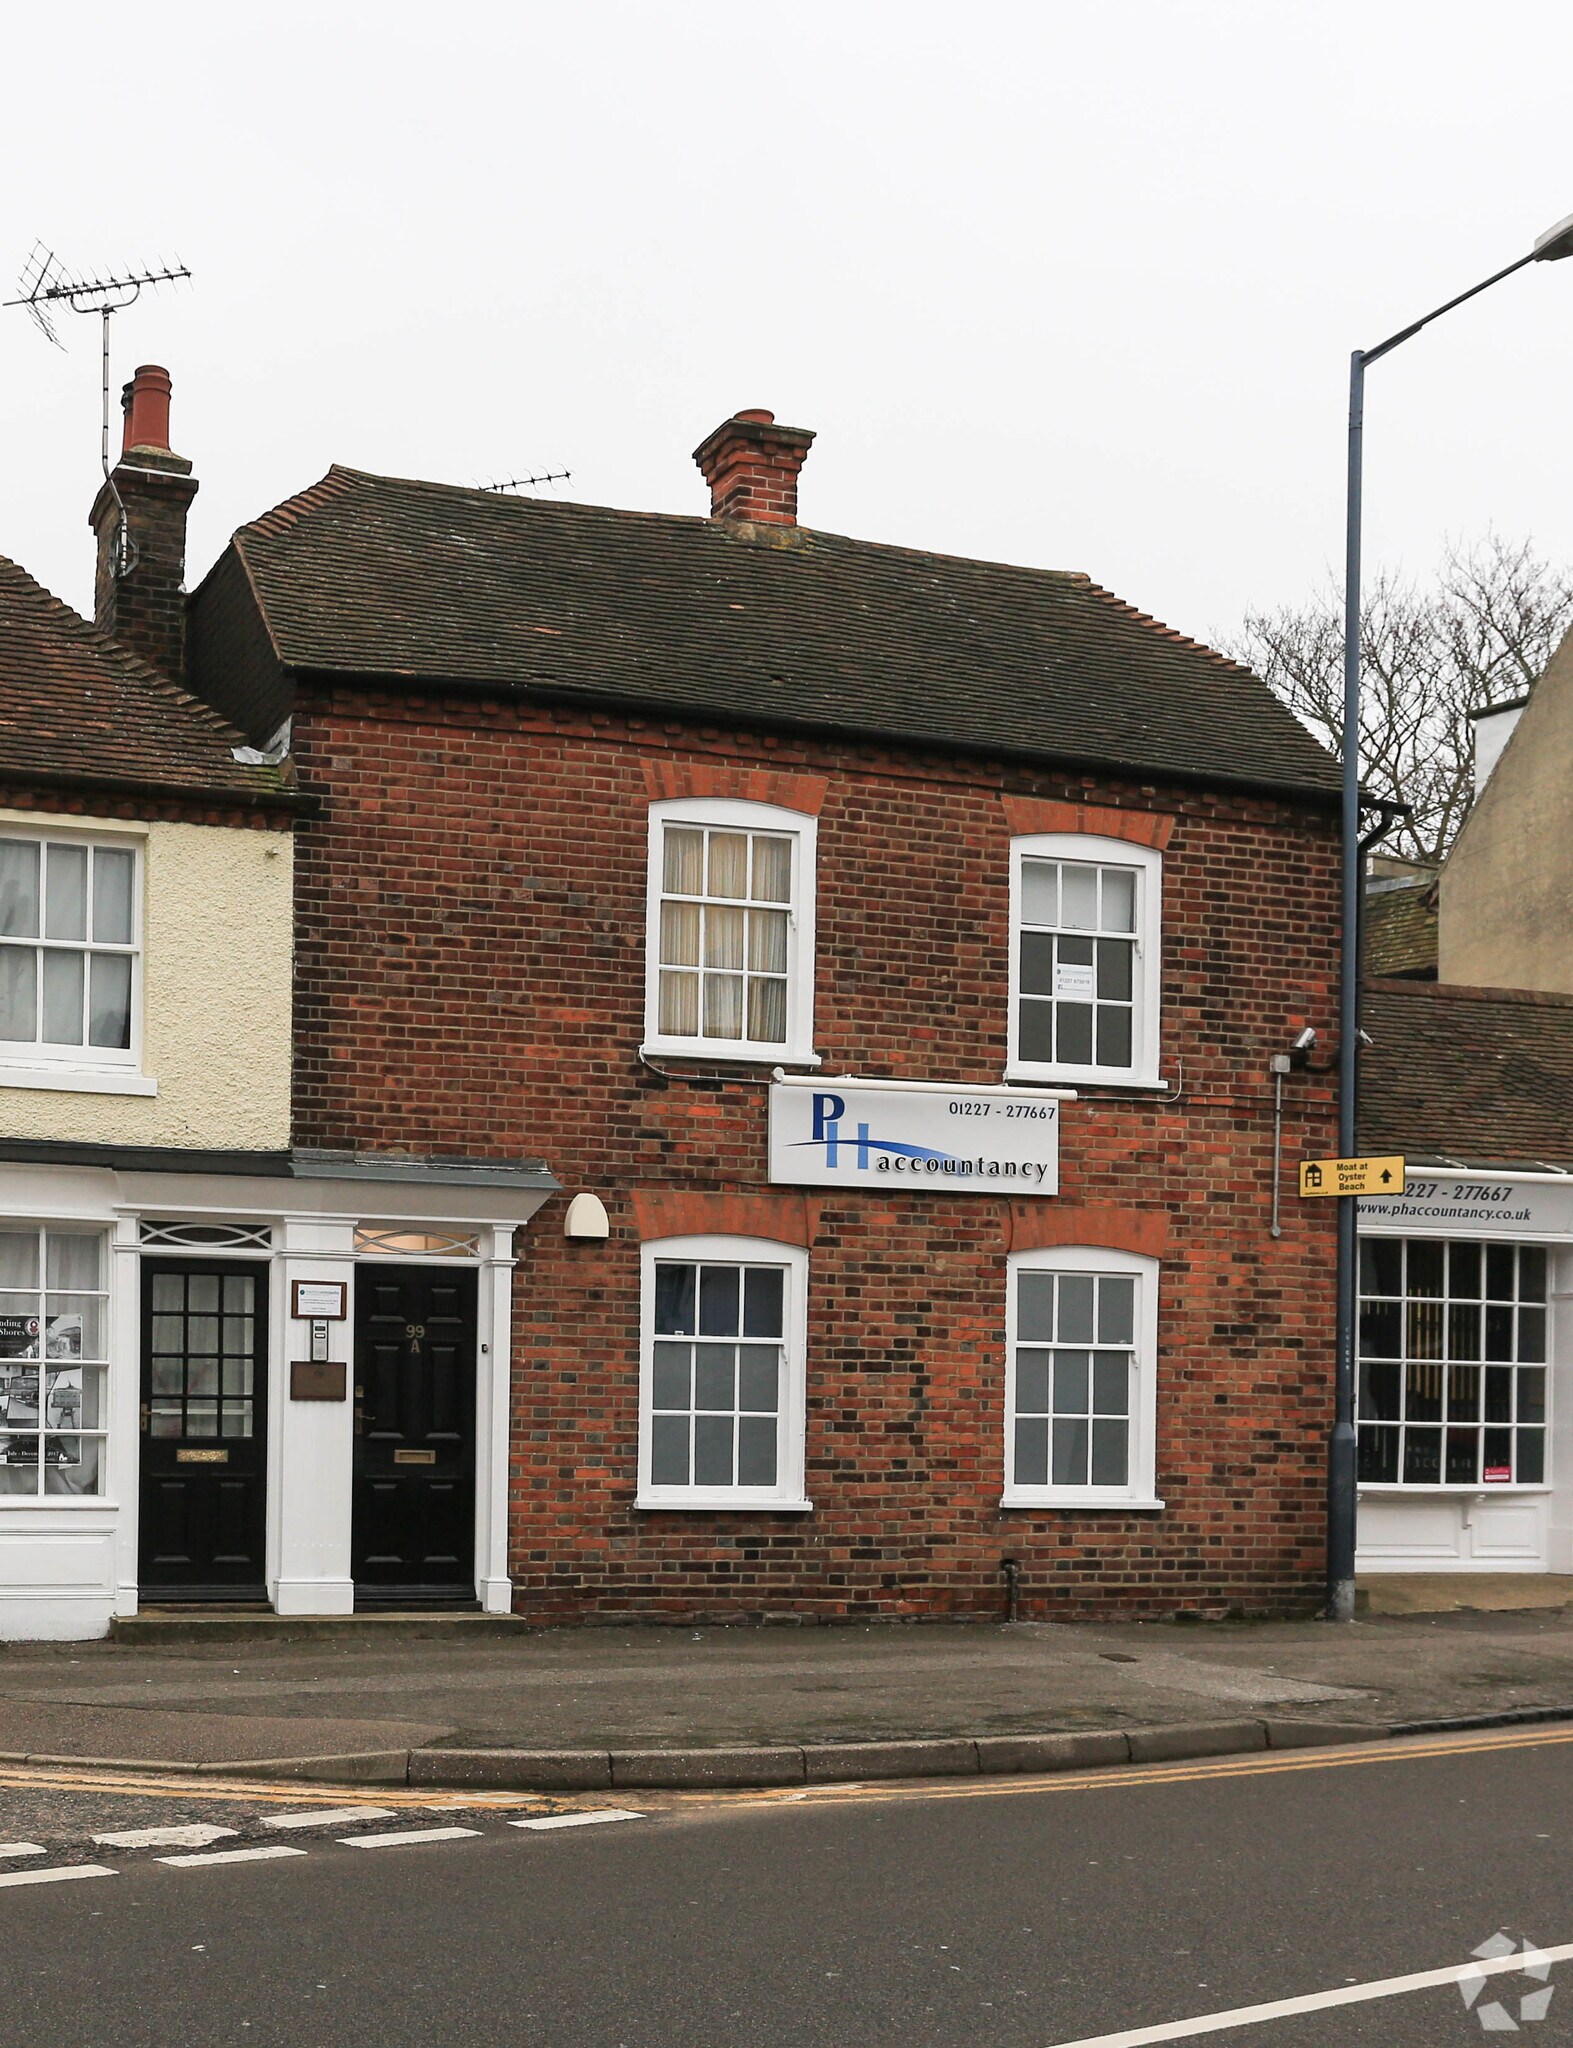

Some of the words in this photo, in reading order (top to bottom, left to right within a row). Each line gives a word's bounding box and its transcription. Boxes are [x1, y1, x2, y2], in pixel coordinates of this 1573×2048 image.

[949, 1101, 990, 1117] 01227
[1005, 1104, 1056, 1120] 277667
[878, 1155, 1048, 1183] accountancy
[1336, 1163, 1358, 1172] Moat
[1359, 1162, 1369, 1171] at
[1338, 1173, 1366, 1182] Oyster
[1338, 1182, 1366, 1191] Beach
[1390, 1182, 1438, 1198] 227
[1452, 1185, 1513, 1202] 277667
[1356, 1202, 1532, 1221] www.phaccountancy.co.uk
[405, 1324, 426, 1339] 99
[410, 1339, 421, 1354] A
